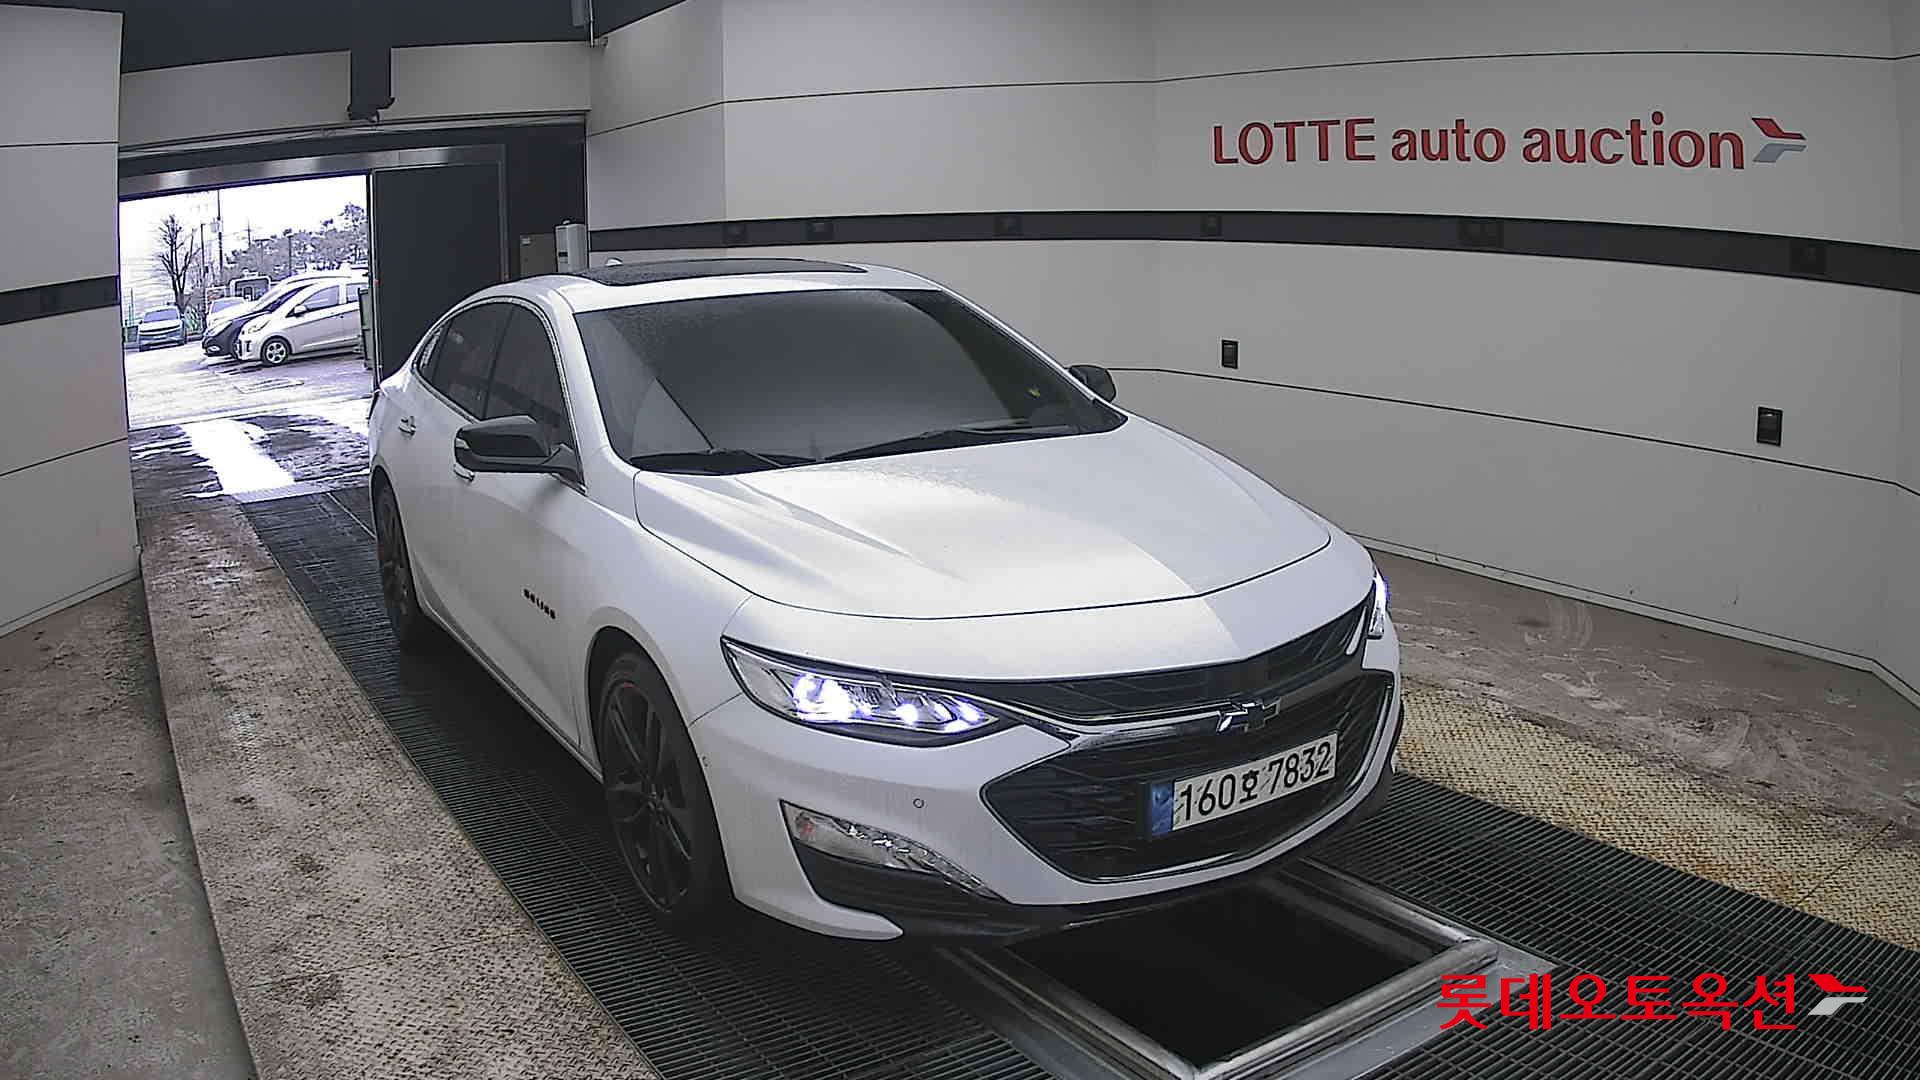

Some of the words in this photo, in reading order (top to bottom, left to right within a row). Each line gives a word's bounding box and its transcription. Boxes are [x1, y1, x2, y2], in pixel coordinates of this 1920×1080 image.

[1213, 118, 1376, 165] LOTTE
[1391, 118, 1506, 163] auto
[1522, 111, 1744, 169] auction
